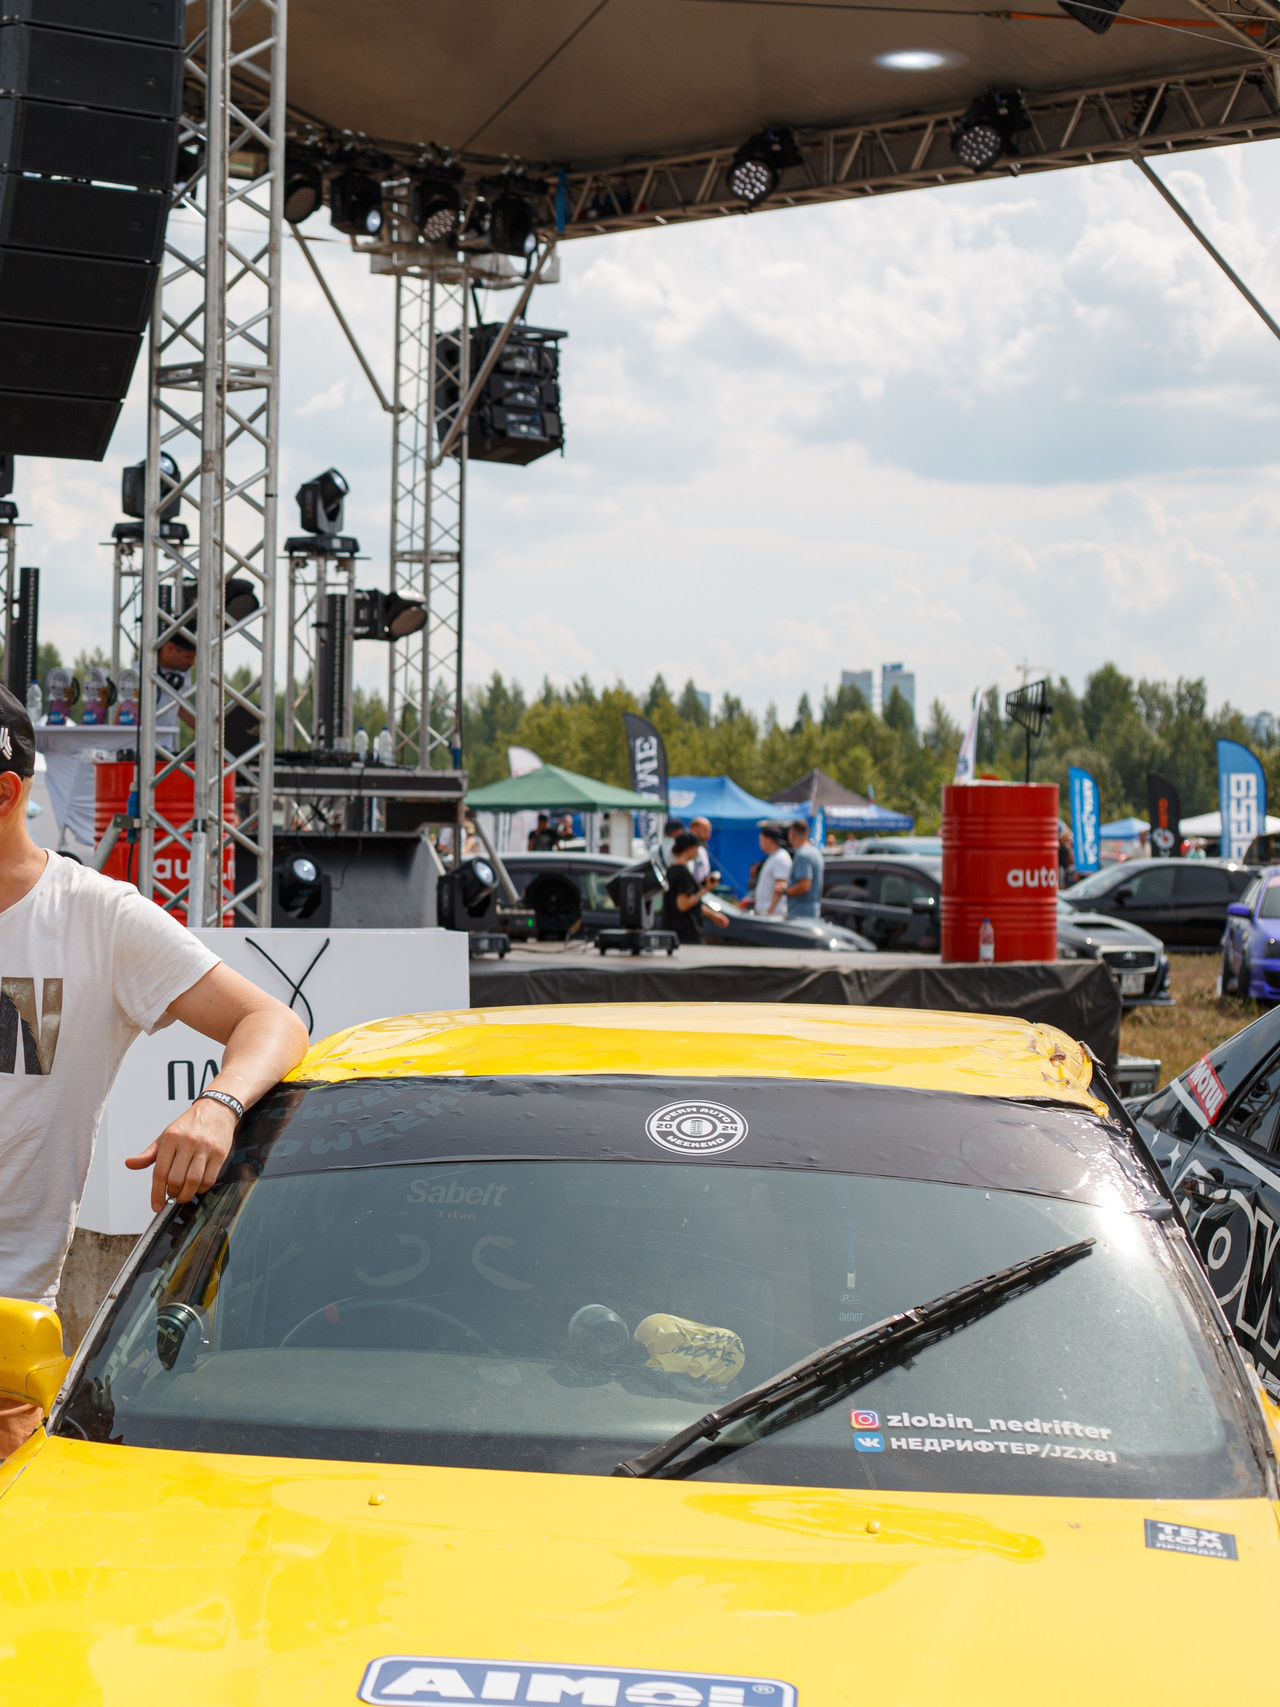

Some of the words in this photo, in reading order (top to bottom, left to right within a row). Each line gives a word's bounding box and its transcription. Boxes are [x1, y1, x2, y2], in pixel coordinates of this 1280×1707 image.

[1189, 1058, 1224, 1118] MOTUL
[656, 1122, 673, 1130] 20
[663, 1107, 697, 1121] PERM
[700, 1107, 732, 1123] AUTO
[666, 1135, 726, 1148] WEEKEND
[406, 1179, 509, 1207] Sabelt
[886, 1412, 1112, 1441] zlobin_nedrifter
[889, 1436, 1119, 1464] НЕДРИФТЕР/JZX81
